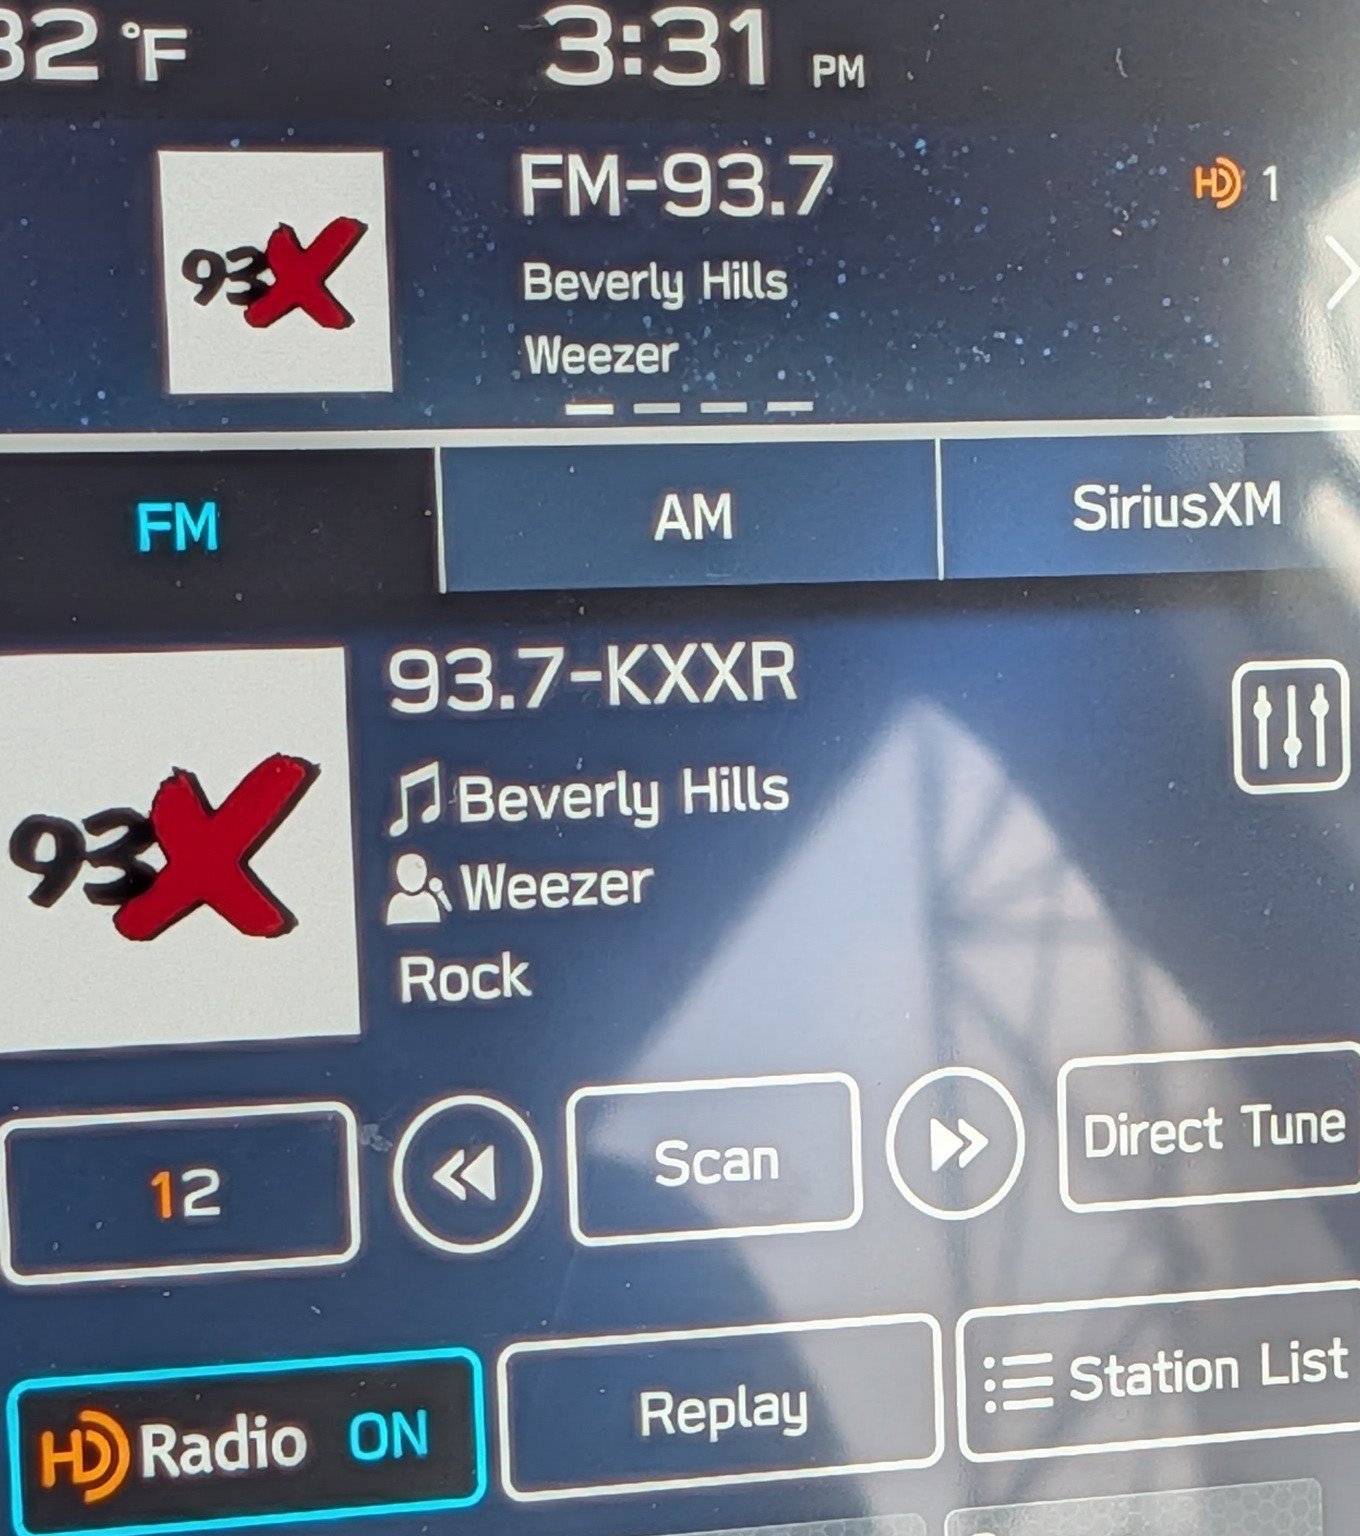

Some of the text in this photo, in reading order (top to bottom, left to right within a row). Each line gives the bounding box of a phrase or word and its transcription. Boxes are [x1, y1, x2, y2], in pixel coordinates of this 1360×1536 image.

[542, 3, 867, 89] 3:31 PM
[519, 151, 836, 221] FM-93.7
[1261, 165, 1279, 202] 1
[522, 260, 789, 312] Beverly Hills
[524, 334, 680, 377] Weezer
[138, 500, 220, 553] FM
[653, 491, 734, 543] AM
[1071, 479, 1283, 534] SiriusXM
[387, 639, 798, 716] 93.7-KXXR
[457, 763, 791, 829] Beverly Hills
[459, 859, 655, 912] Weezer
[399, 950, 533, 1004] Rock
[1084, 1100, 1348, 1161] Direct Tune
[654, 1138, 781, 1189] Scan
[150, 1167, 223, 1222] 12
[1068, 1339, 1350, 1403] Station List
[639, 1383, 809, 1444] Replay
[140, 1412, 309, 1480] Radio
[348, 1408, 429, 1463] ON
